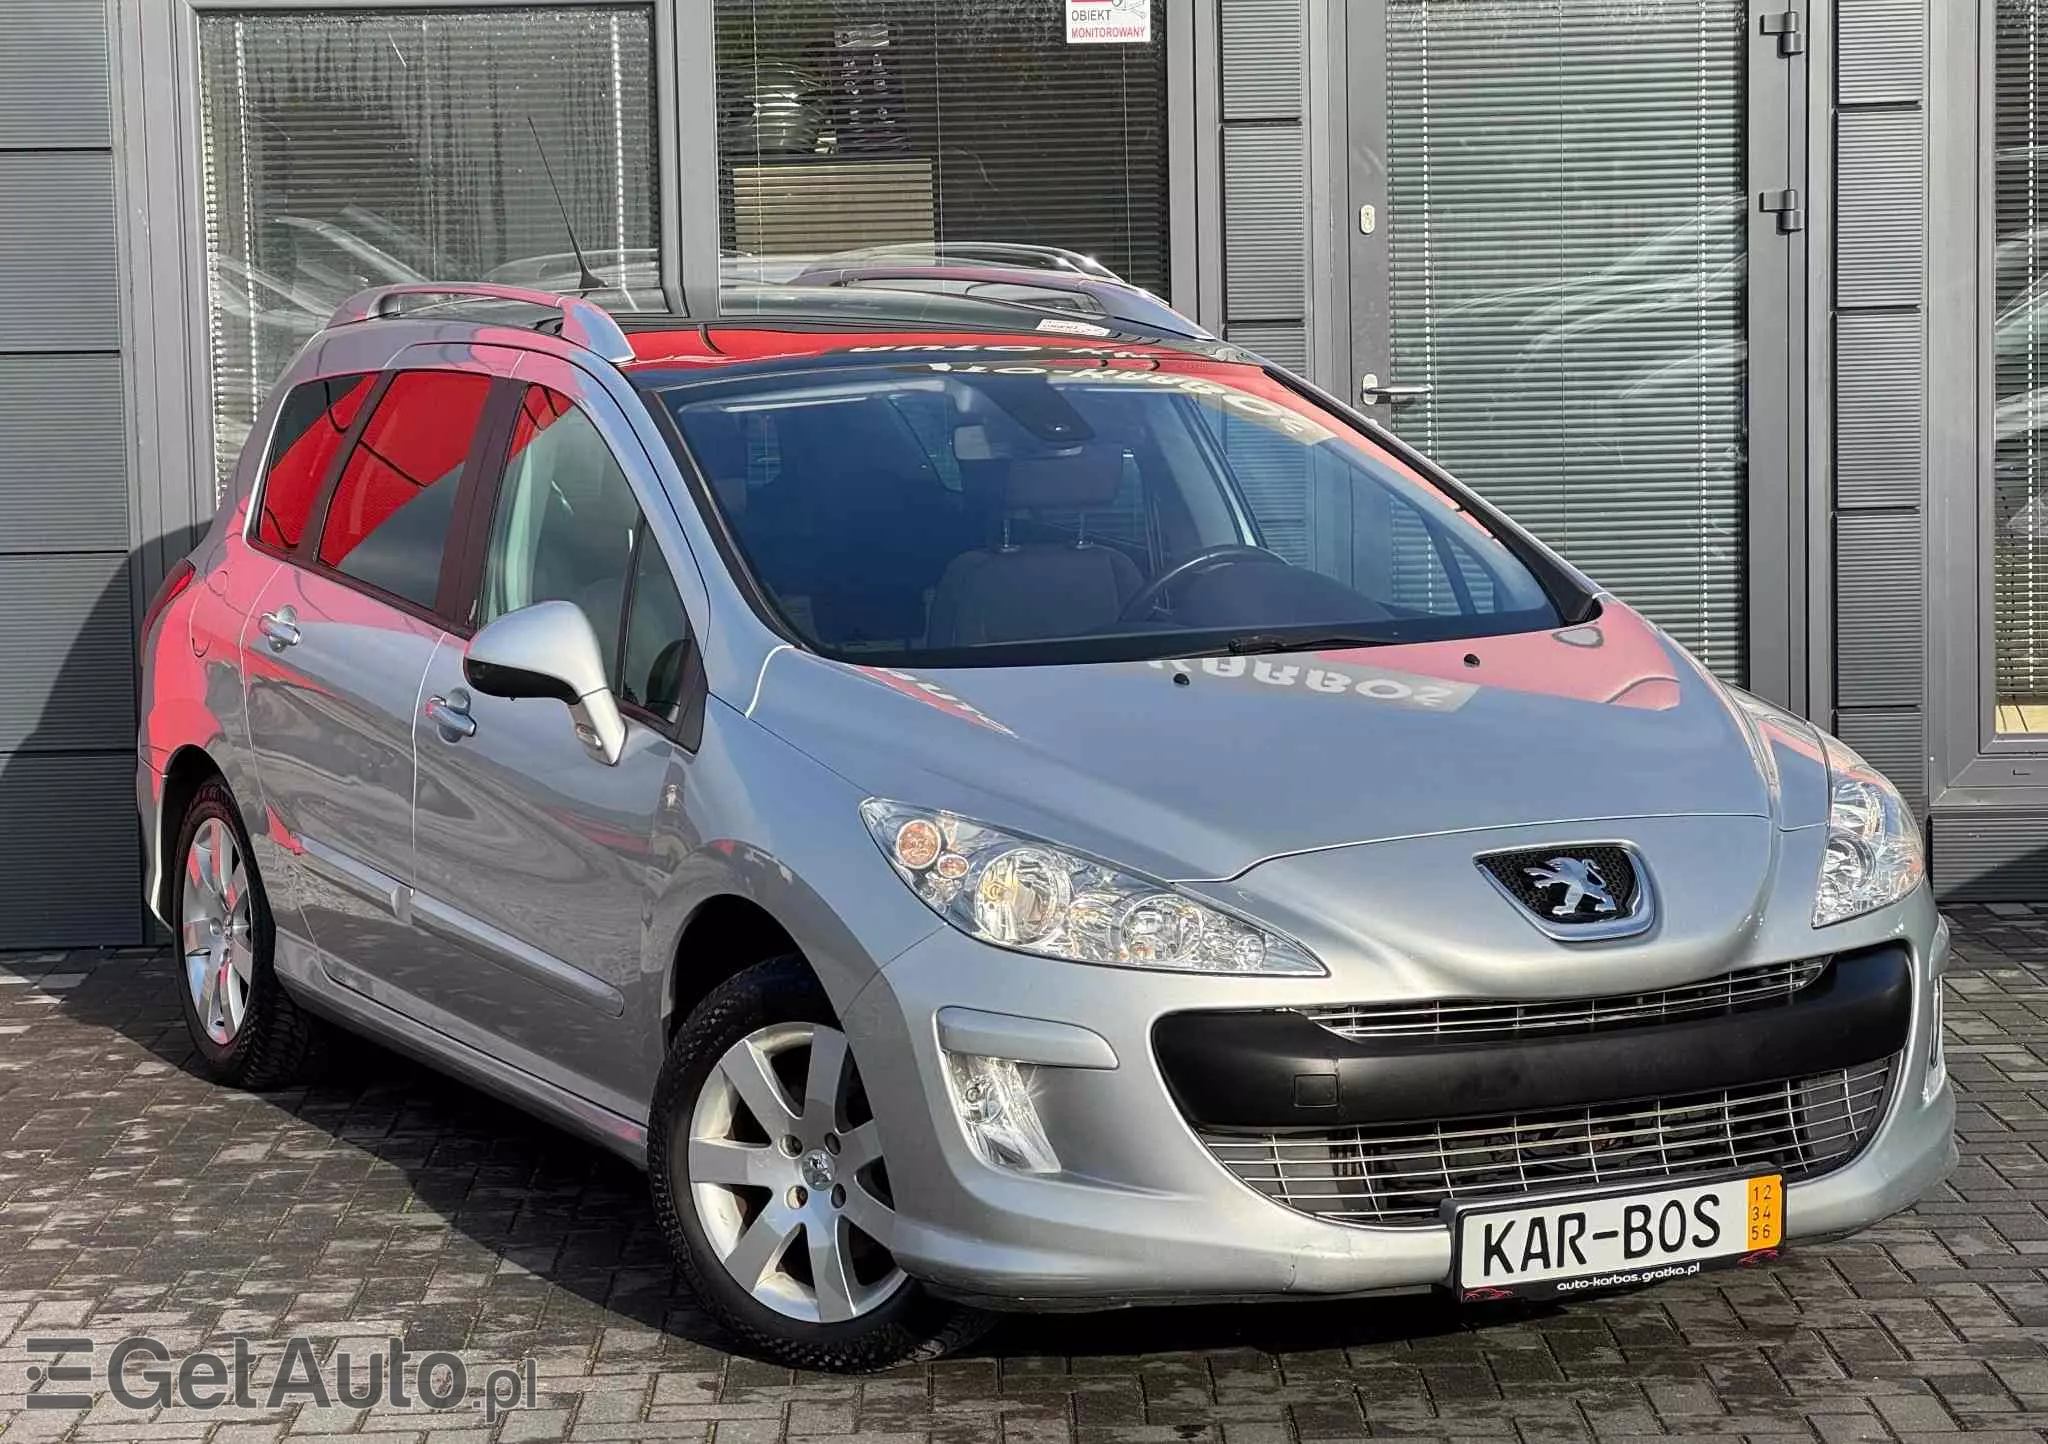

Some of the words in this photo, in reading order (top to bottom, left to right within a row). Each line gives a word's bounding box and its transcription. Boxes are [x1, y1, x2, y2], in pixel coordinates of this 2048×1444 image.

[1071, 9, 1112, 21] OBIEKT
[1071, 27, 1145, 38] MONITOROWANY
[1752, 1184, 1772, 1201] 12
[1751, 1205, 1771, 1221] 34
[1483, 1193, 1721, 1277] KAR-BOS
[1751, 1223, 1771, 1240] 56
[1556, 1262, 1701, 1291] auto-karbos.gratka.pl
